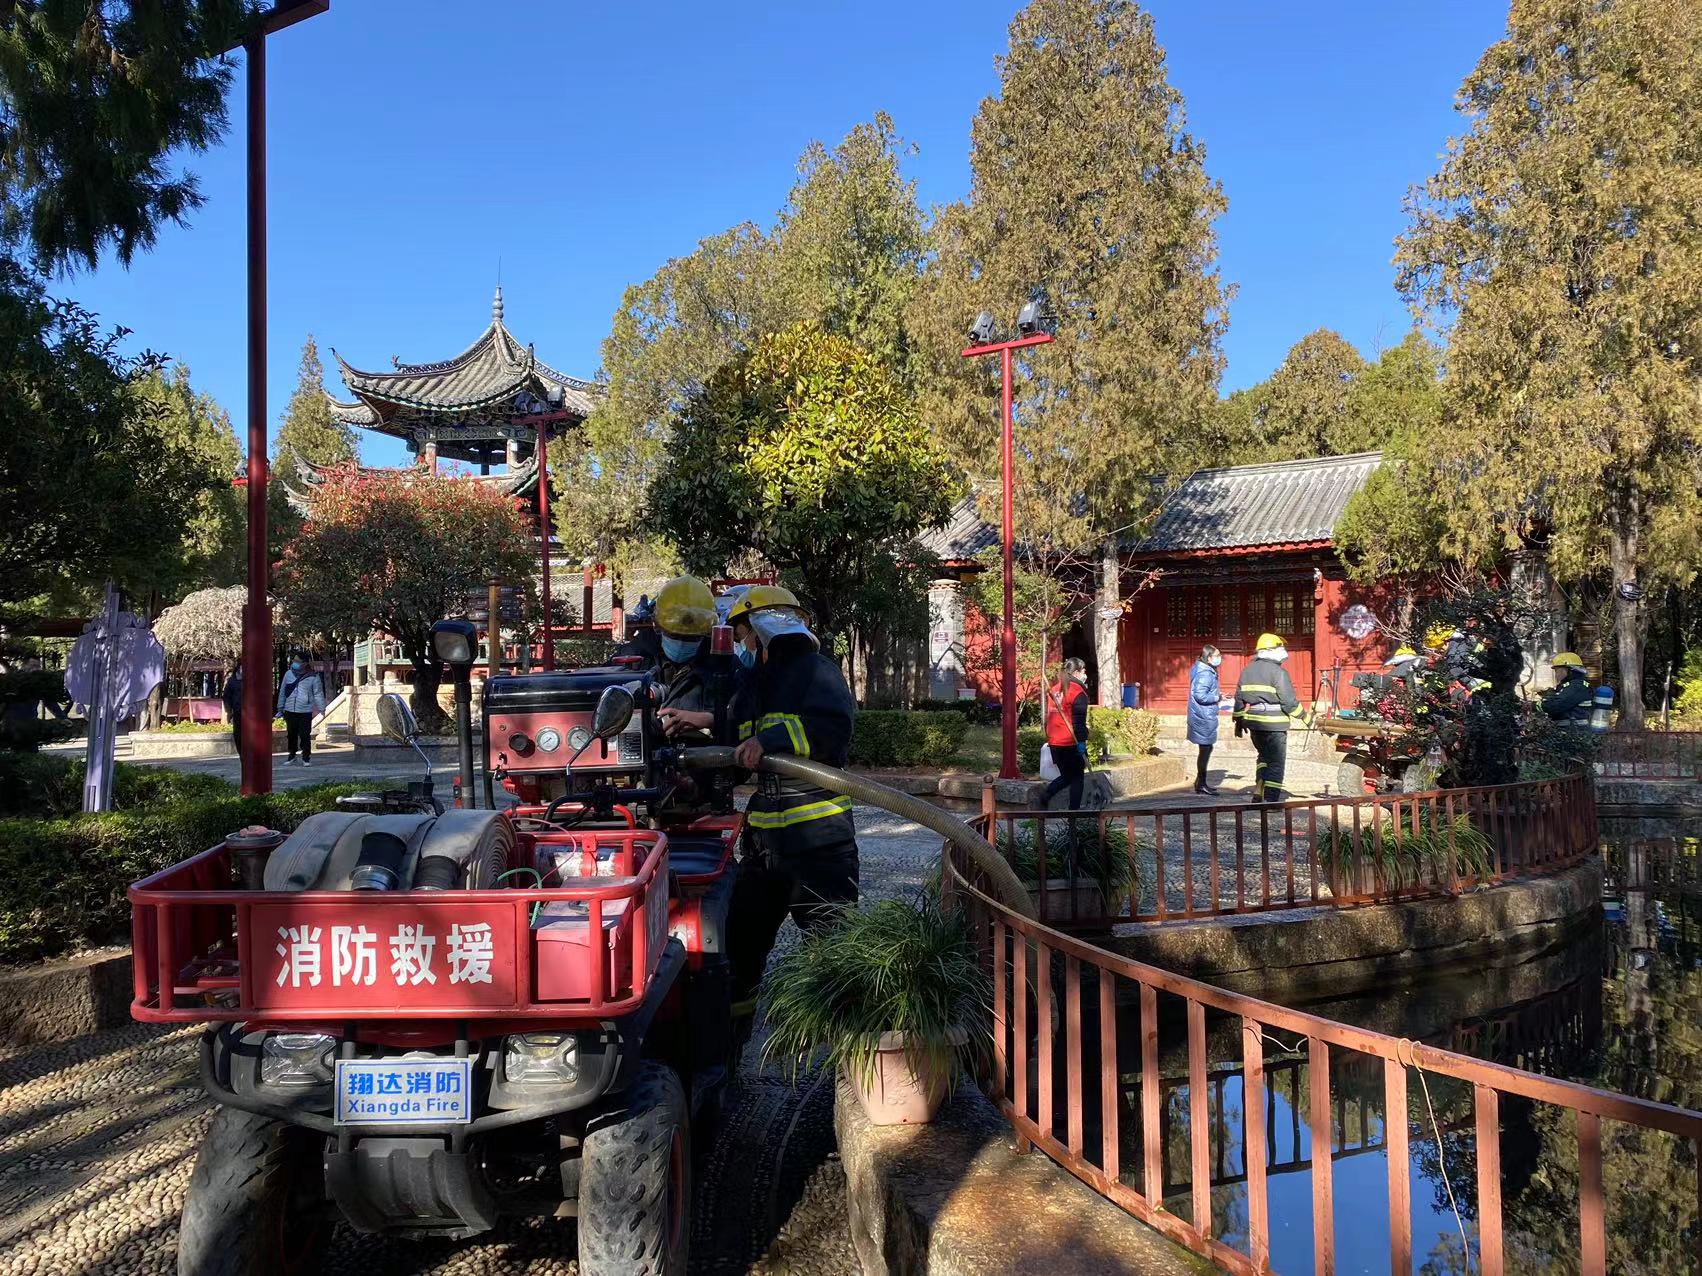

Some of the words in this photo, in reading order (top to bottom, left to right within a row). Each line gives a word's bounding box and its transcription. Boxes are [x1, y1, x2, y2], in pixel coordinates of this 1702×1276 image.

[275, 922, 494, 988] 消防救援
[348, 1071, 461, 1095] 翔达消防
[348, 1099, 420, 1116] Xiangda
[426, 1098, 460, 1112] Fire
